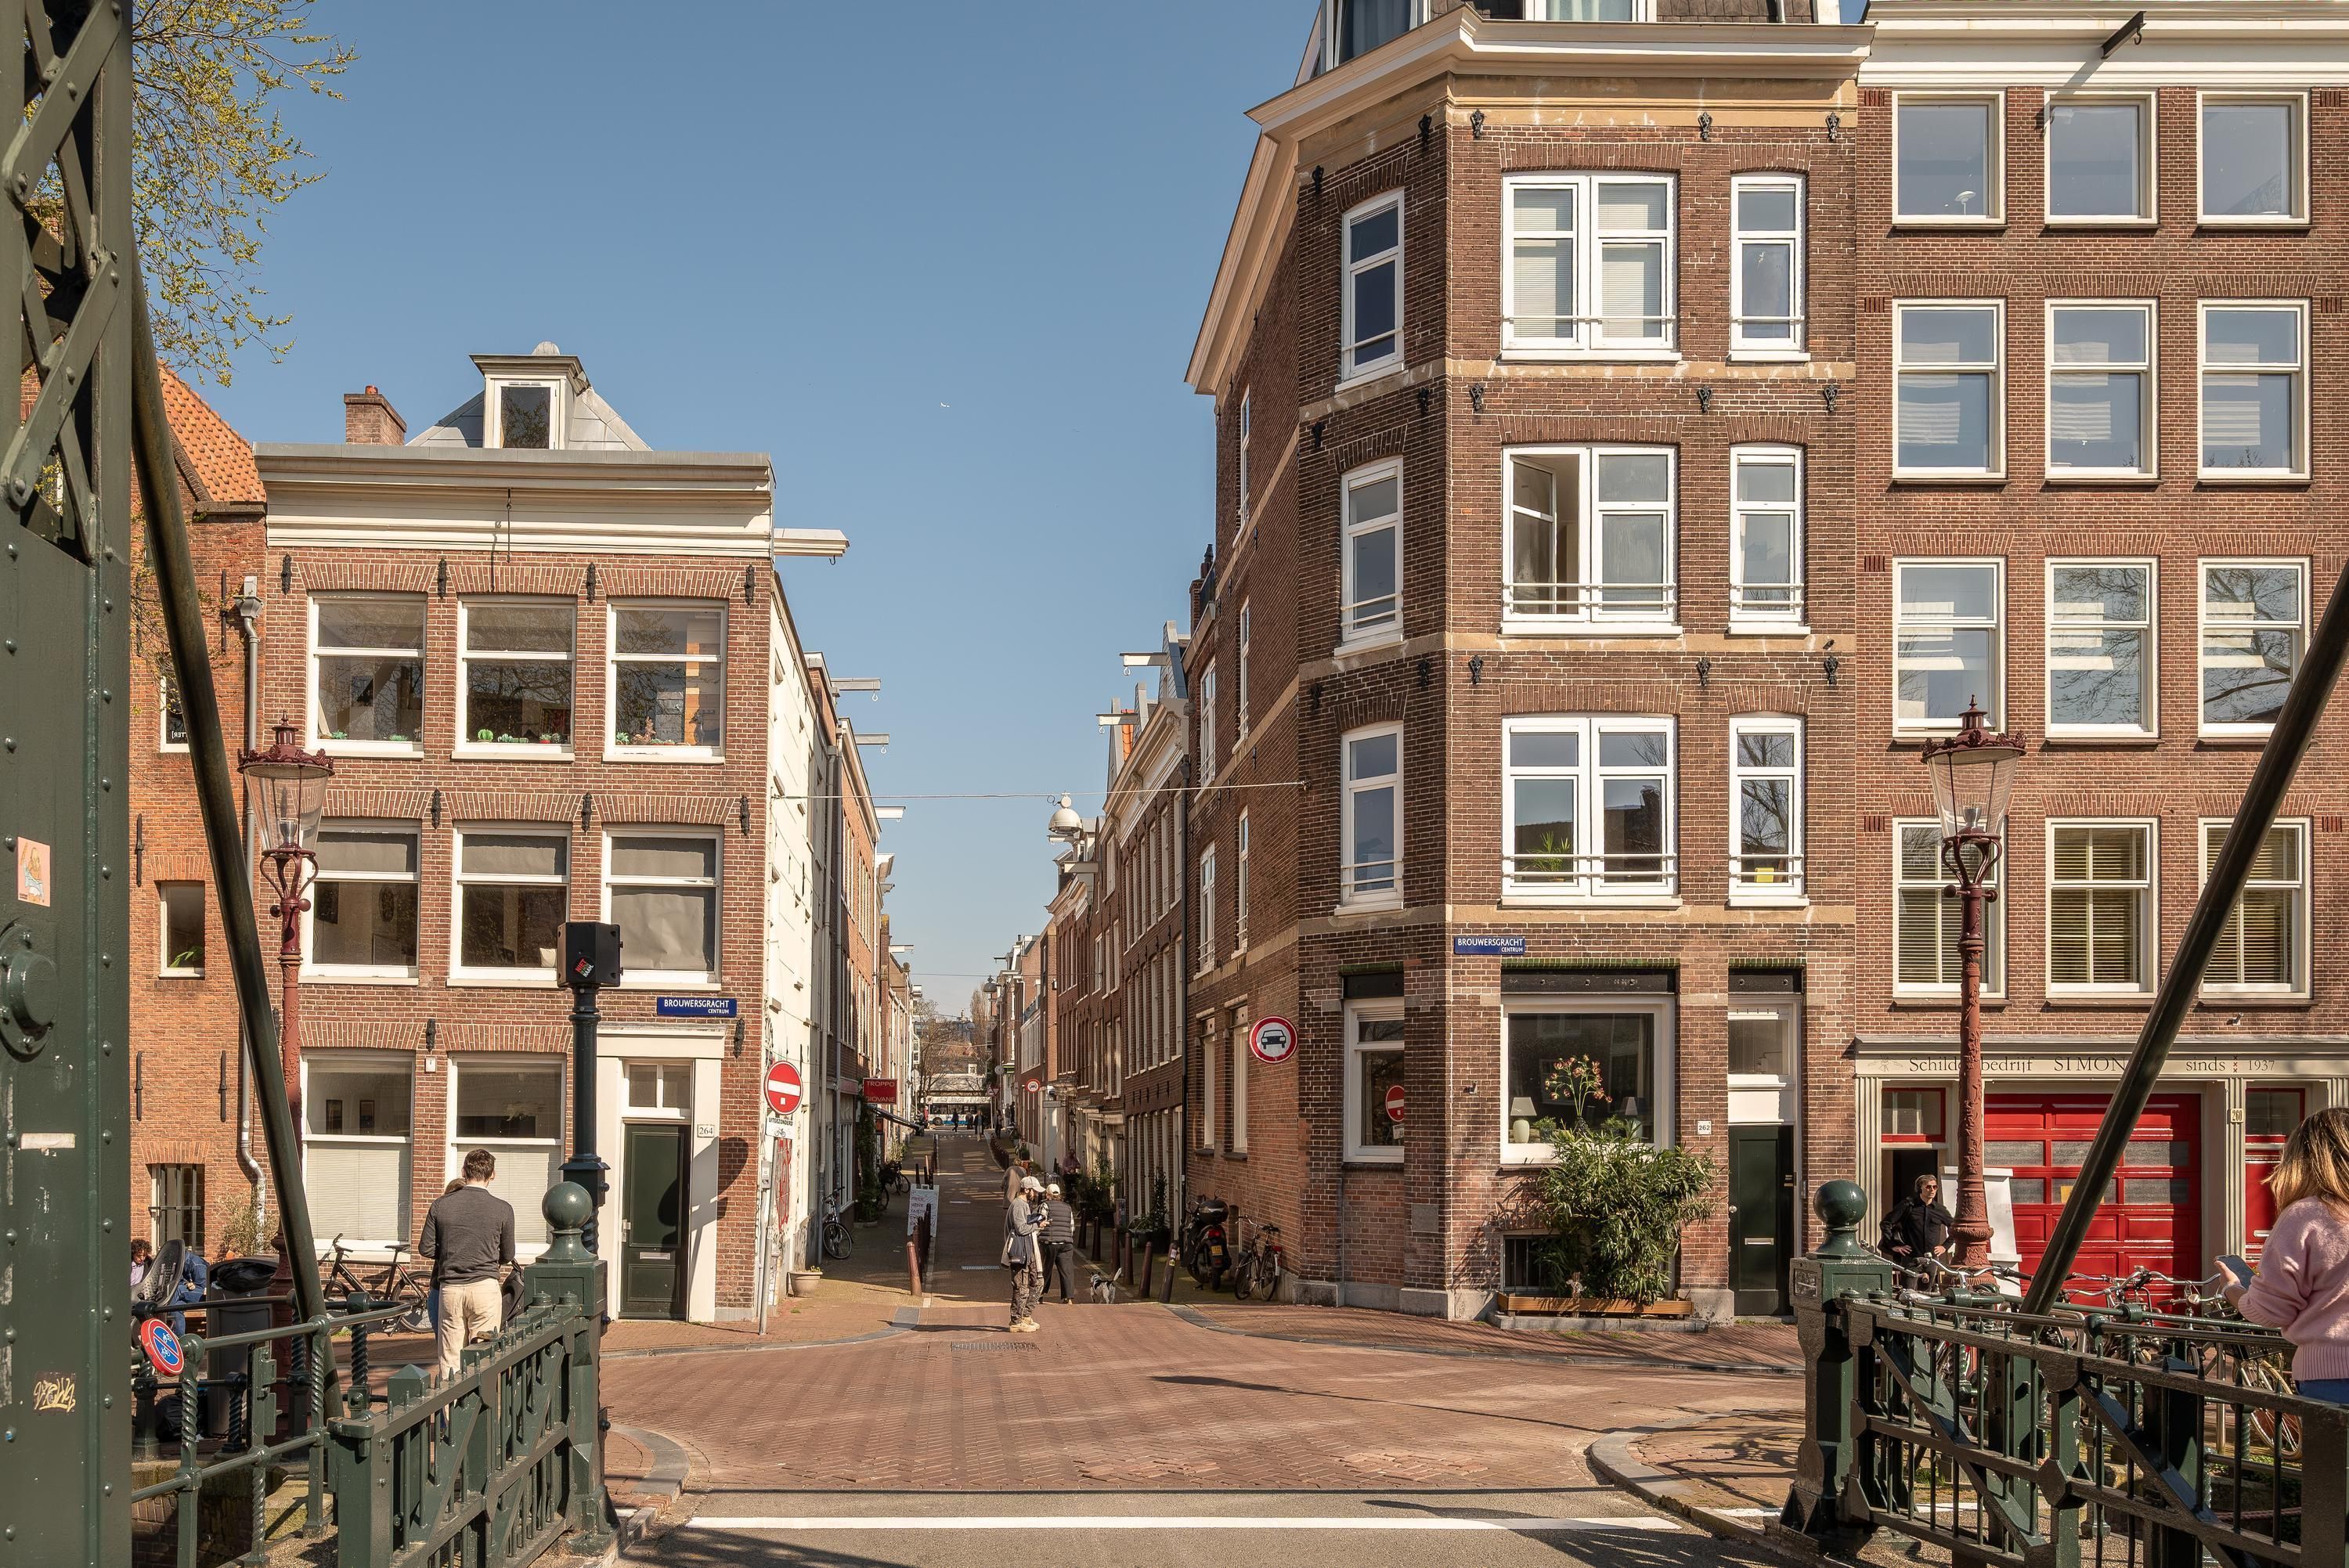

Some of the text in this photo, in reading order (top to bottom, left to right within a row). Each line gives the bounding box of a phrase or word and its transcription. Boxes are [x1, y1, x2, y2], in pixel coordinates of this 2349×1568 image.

[1457, 938, 1523, 946] BROUWERSGRACHT
[664, 999, 729, 1007] BROUWERSGRACHT
[1909, 1057, 2034, 1073] Schildbedrijf
[2186, 1057, 2225, 1071] sinds
[2248, 1060, 2275, 1071] 1937
[2232, 1110, 2243, 1121] 260
[769, 1117, 792, 1126] UITGEZONDERD
